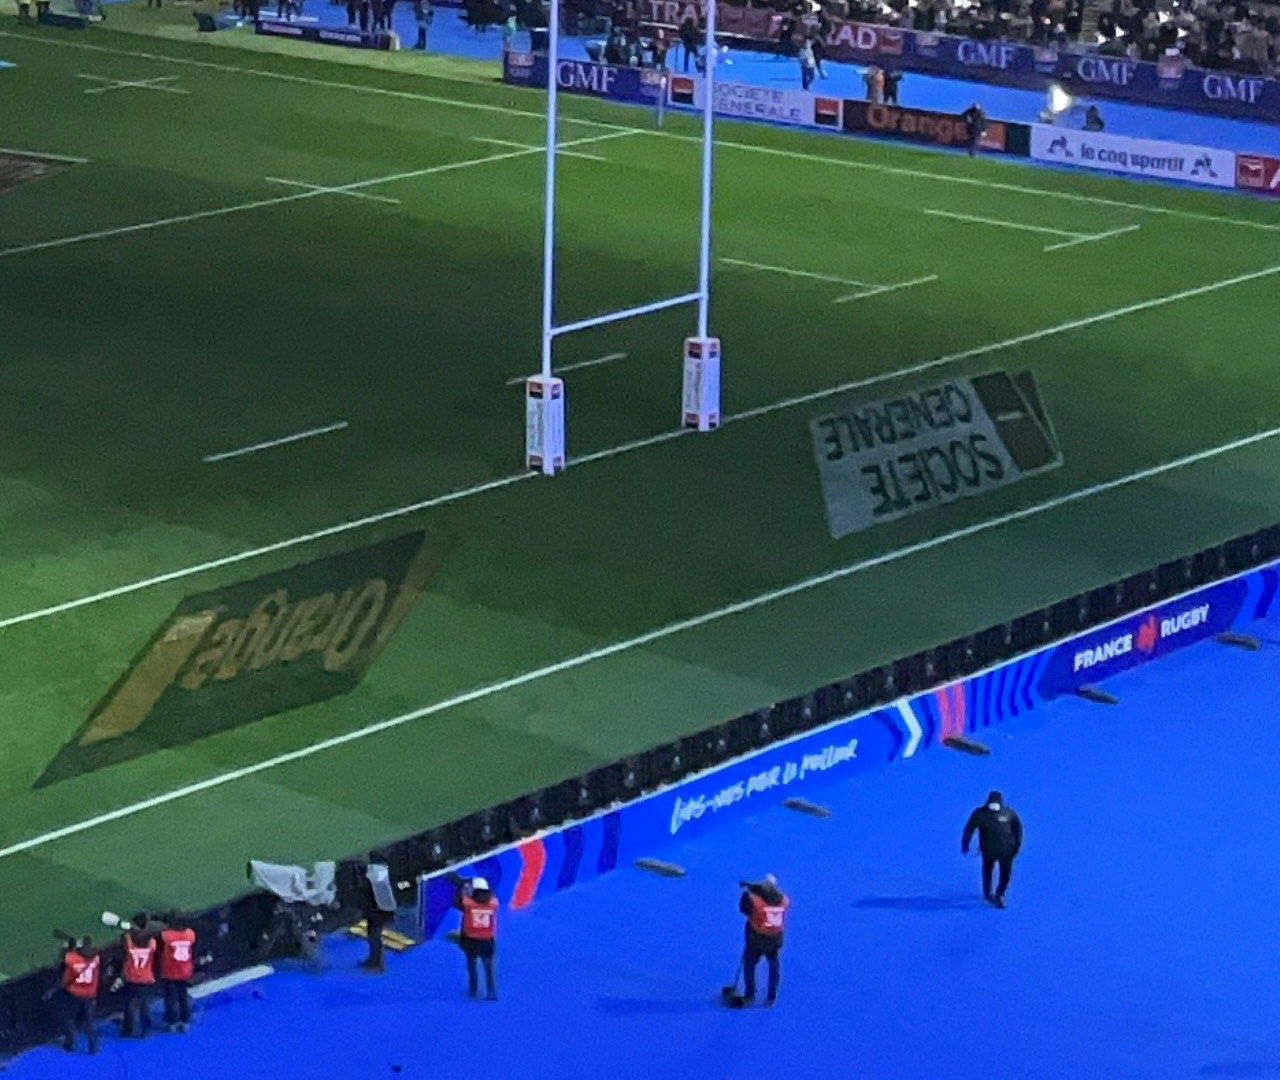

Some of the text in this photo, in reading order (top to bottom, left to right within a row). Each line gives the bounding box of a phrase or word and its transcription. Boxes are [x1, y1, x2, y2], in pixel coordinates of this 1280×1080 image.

[956, 40, 1018, 69] GMF
[1077, 57, 1139, 86] GMF
[556, 60, 618, 94] GMF
[1202, 74, 1264, 104] GMF
[819, 383, 974, 462] GENERALE
[860, 433, 1005, 518] SOCIETE
[1074, 603, 1210, 673] FRANCE RUGBY
